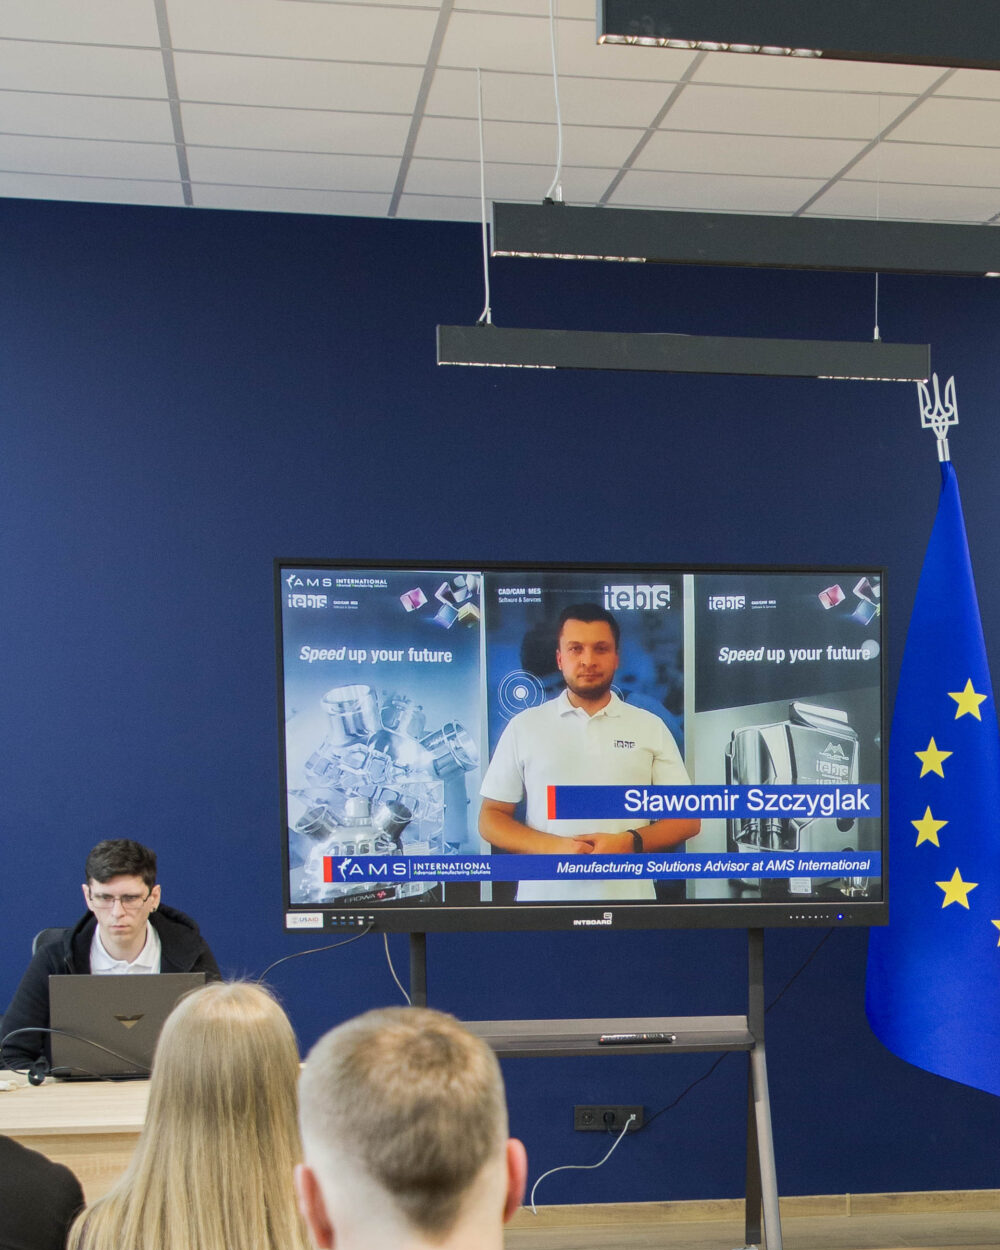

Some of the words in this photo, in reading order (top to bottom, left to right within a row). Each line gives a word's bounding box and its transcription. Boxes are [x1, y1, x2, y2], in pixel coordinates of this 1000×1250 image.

[294, 578, 332, 587] AMS
[300, 646, 346, 662] Speed
[348, 650, 366, 664] up
[371, 650, 404, 664] your
[408, 648, 453, 662] future
[718, 646, 765, 664] Speed
[767, 650, 785, 664] up
[790, 649, 822, 664] your
[827, 645, 871, 660] future
[624, 789, 739, 812] Sławomir
[747, 788, 870, 816] Szczyglak
[349, 863, 407, 875] AMS
[413, 862, 491, 870] INTERNATIONAL
[556, 861, 643, 876] Manufacturing
[646, 860, 701, 873] Solutions
[704, 860, 749, 872] Advisor
[752, 861, 764, 872] at
[766, 859, 795, 871] AMS
[798, 859, 871, 870] International
